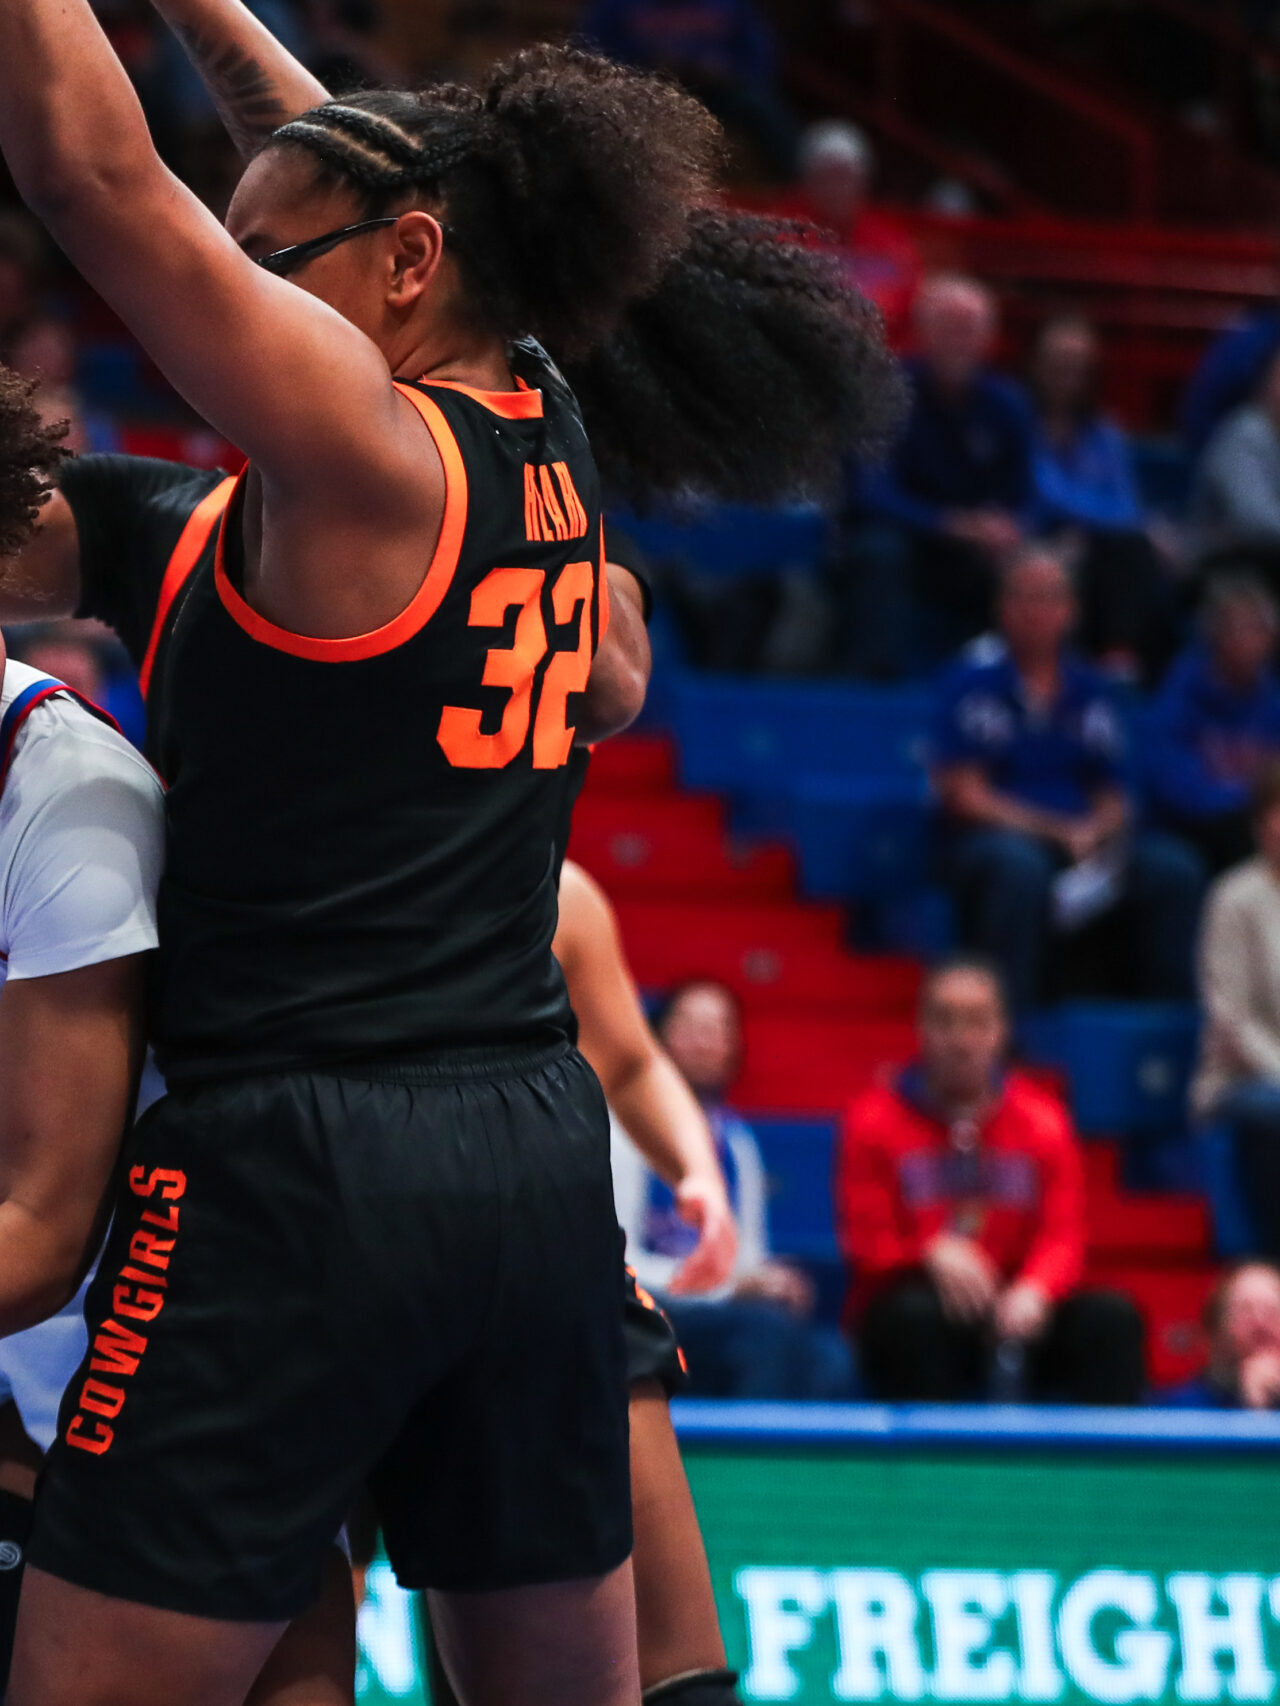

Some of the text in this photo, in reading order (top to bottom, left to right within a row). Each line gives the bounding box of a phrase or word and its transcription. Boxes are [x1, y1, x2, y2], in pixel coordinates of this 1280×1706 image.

[436, 561, 594, 770] 32
[66, 1164, 187, 1455] COWGIRLS
[733, 1566, 1280, 1700] FREIGH
